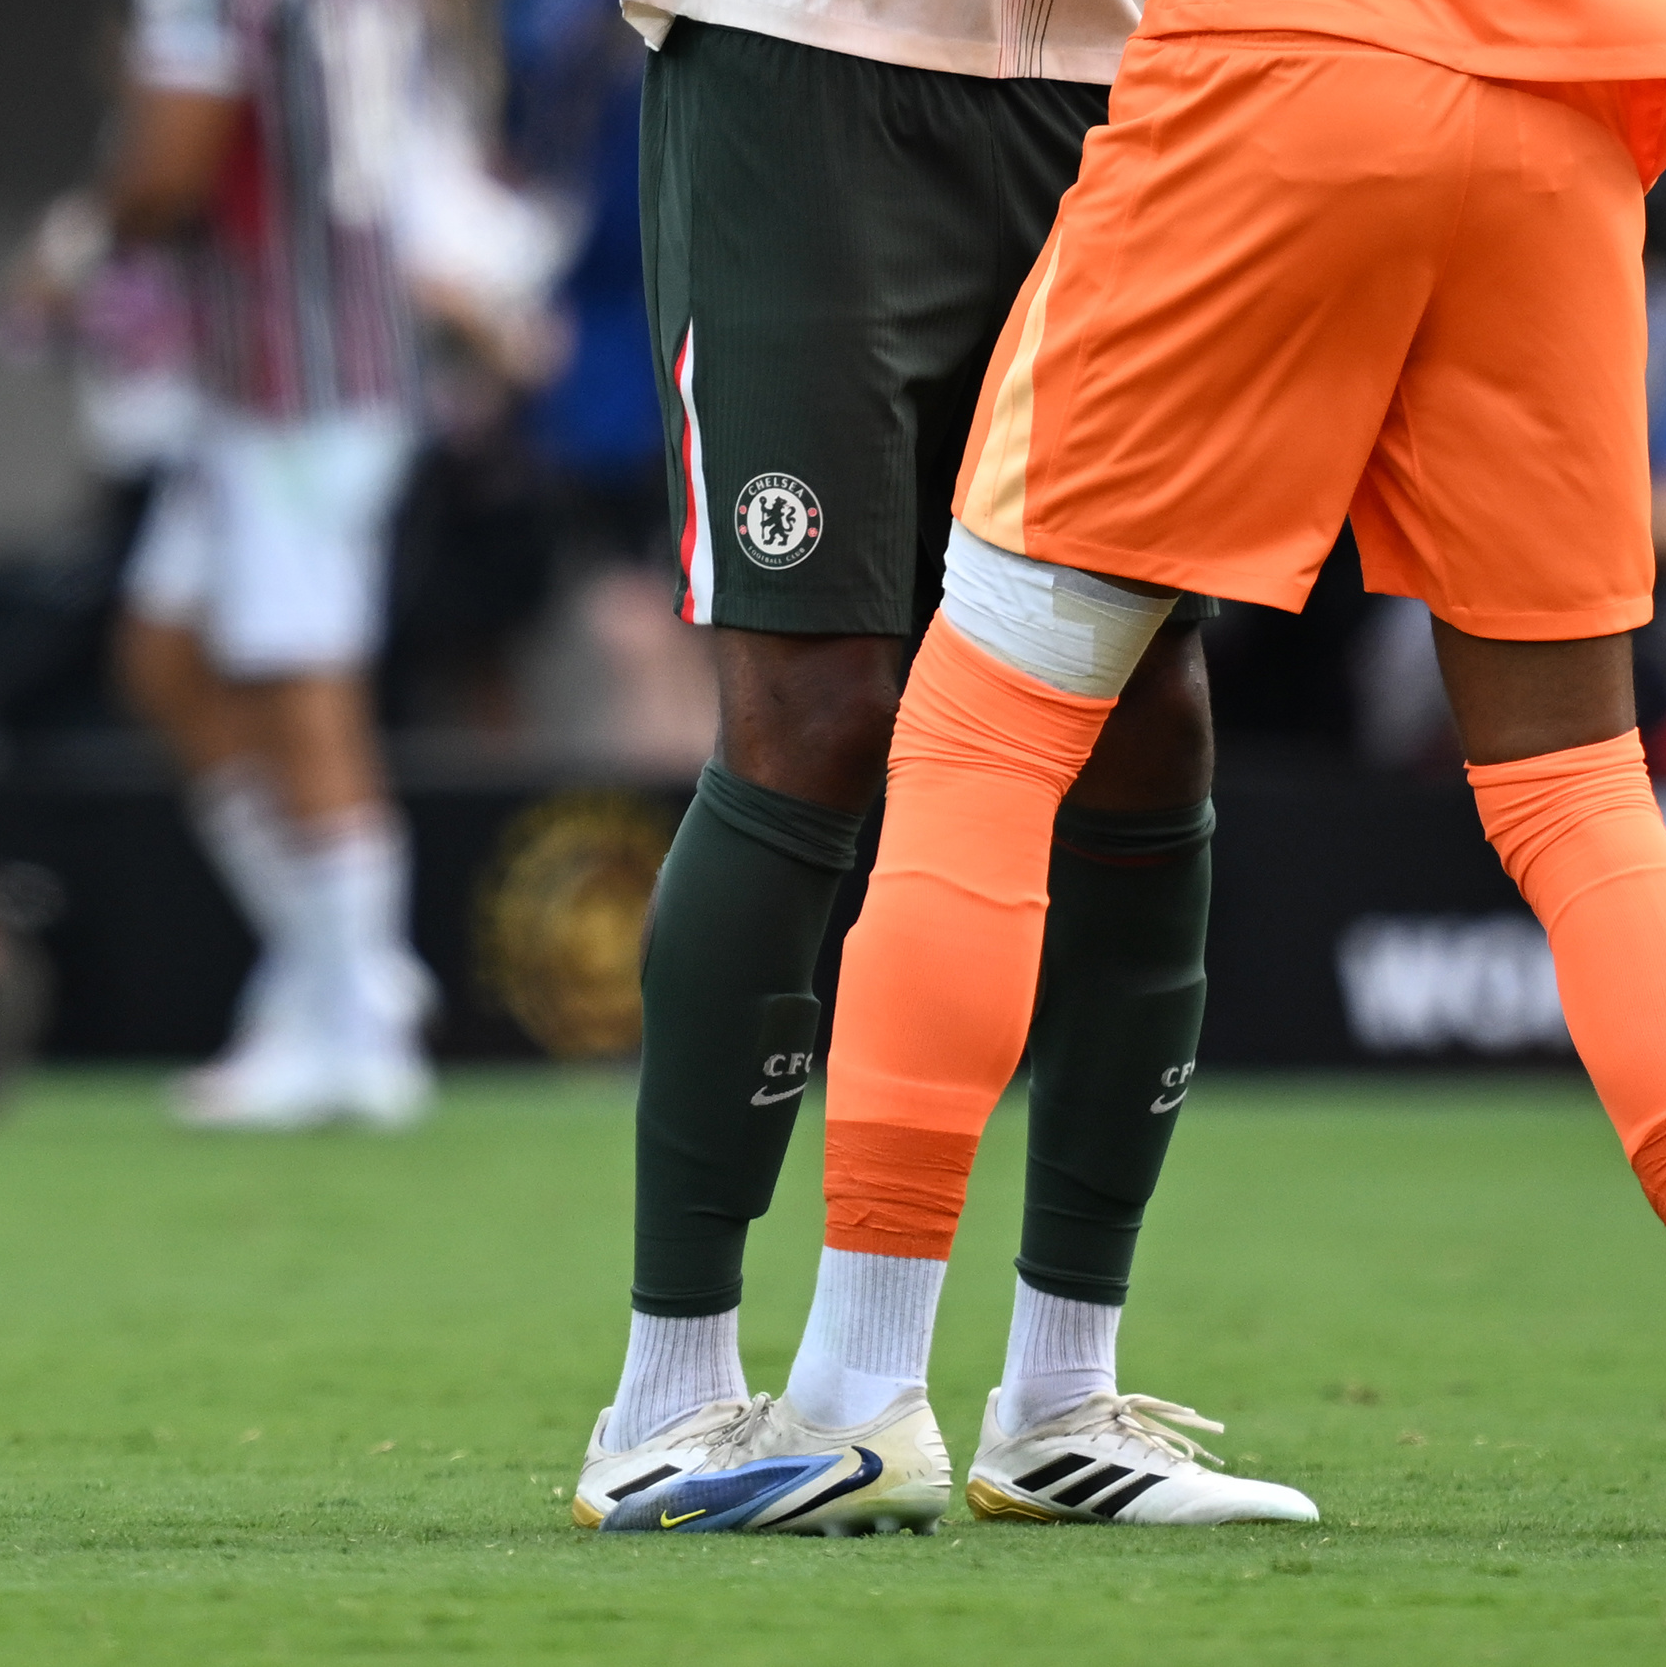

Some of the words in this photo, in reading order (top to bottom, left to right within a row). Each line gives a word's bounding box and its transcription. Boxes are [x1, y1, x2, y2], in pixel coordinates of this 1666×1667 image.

[748, 477, 804, 498] CHELSEA
[785, 547, 806, 562] CLUB
[1161, 1058, 1196, 1087] CF
